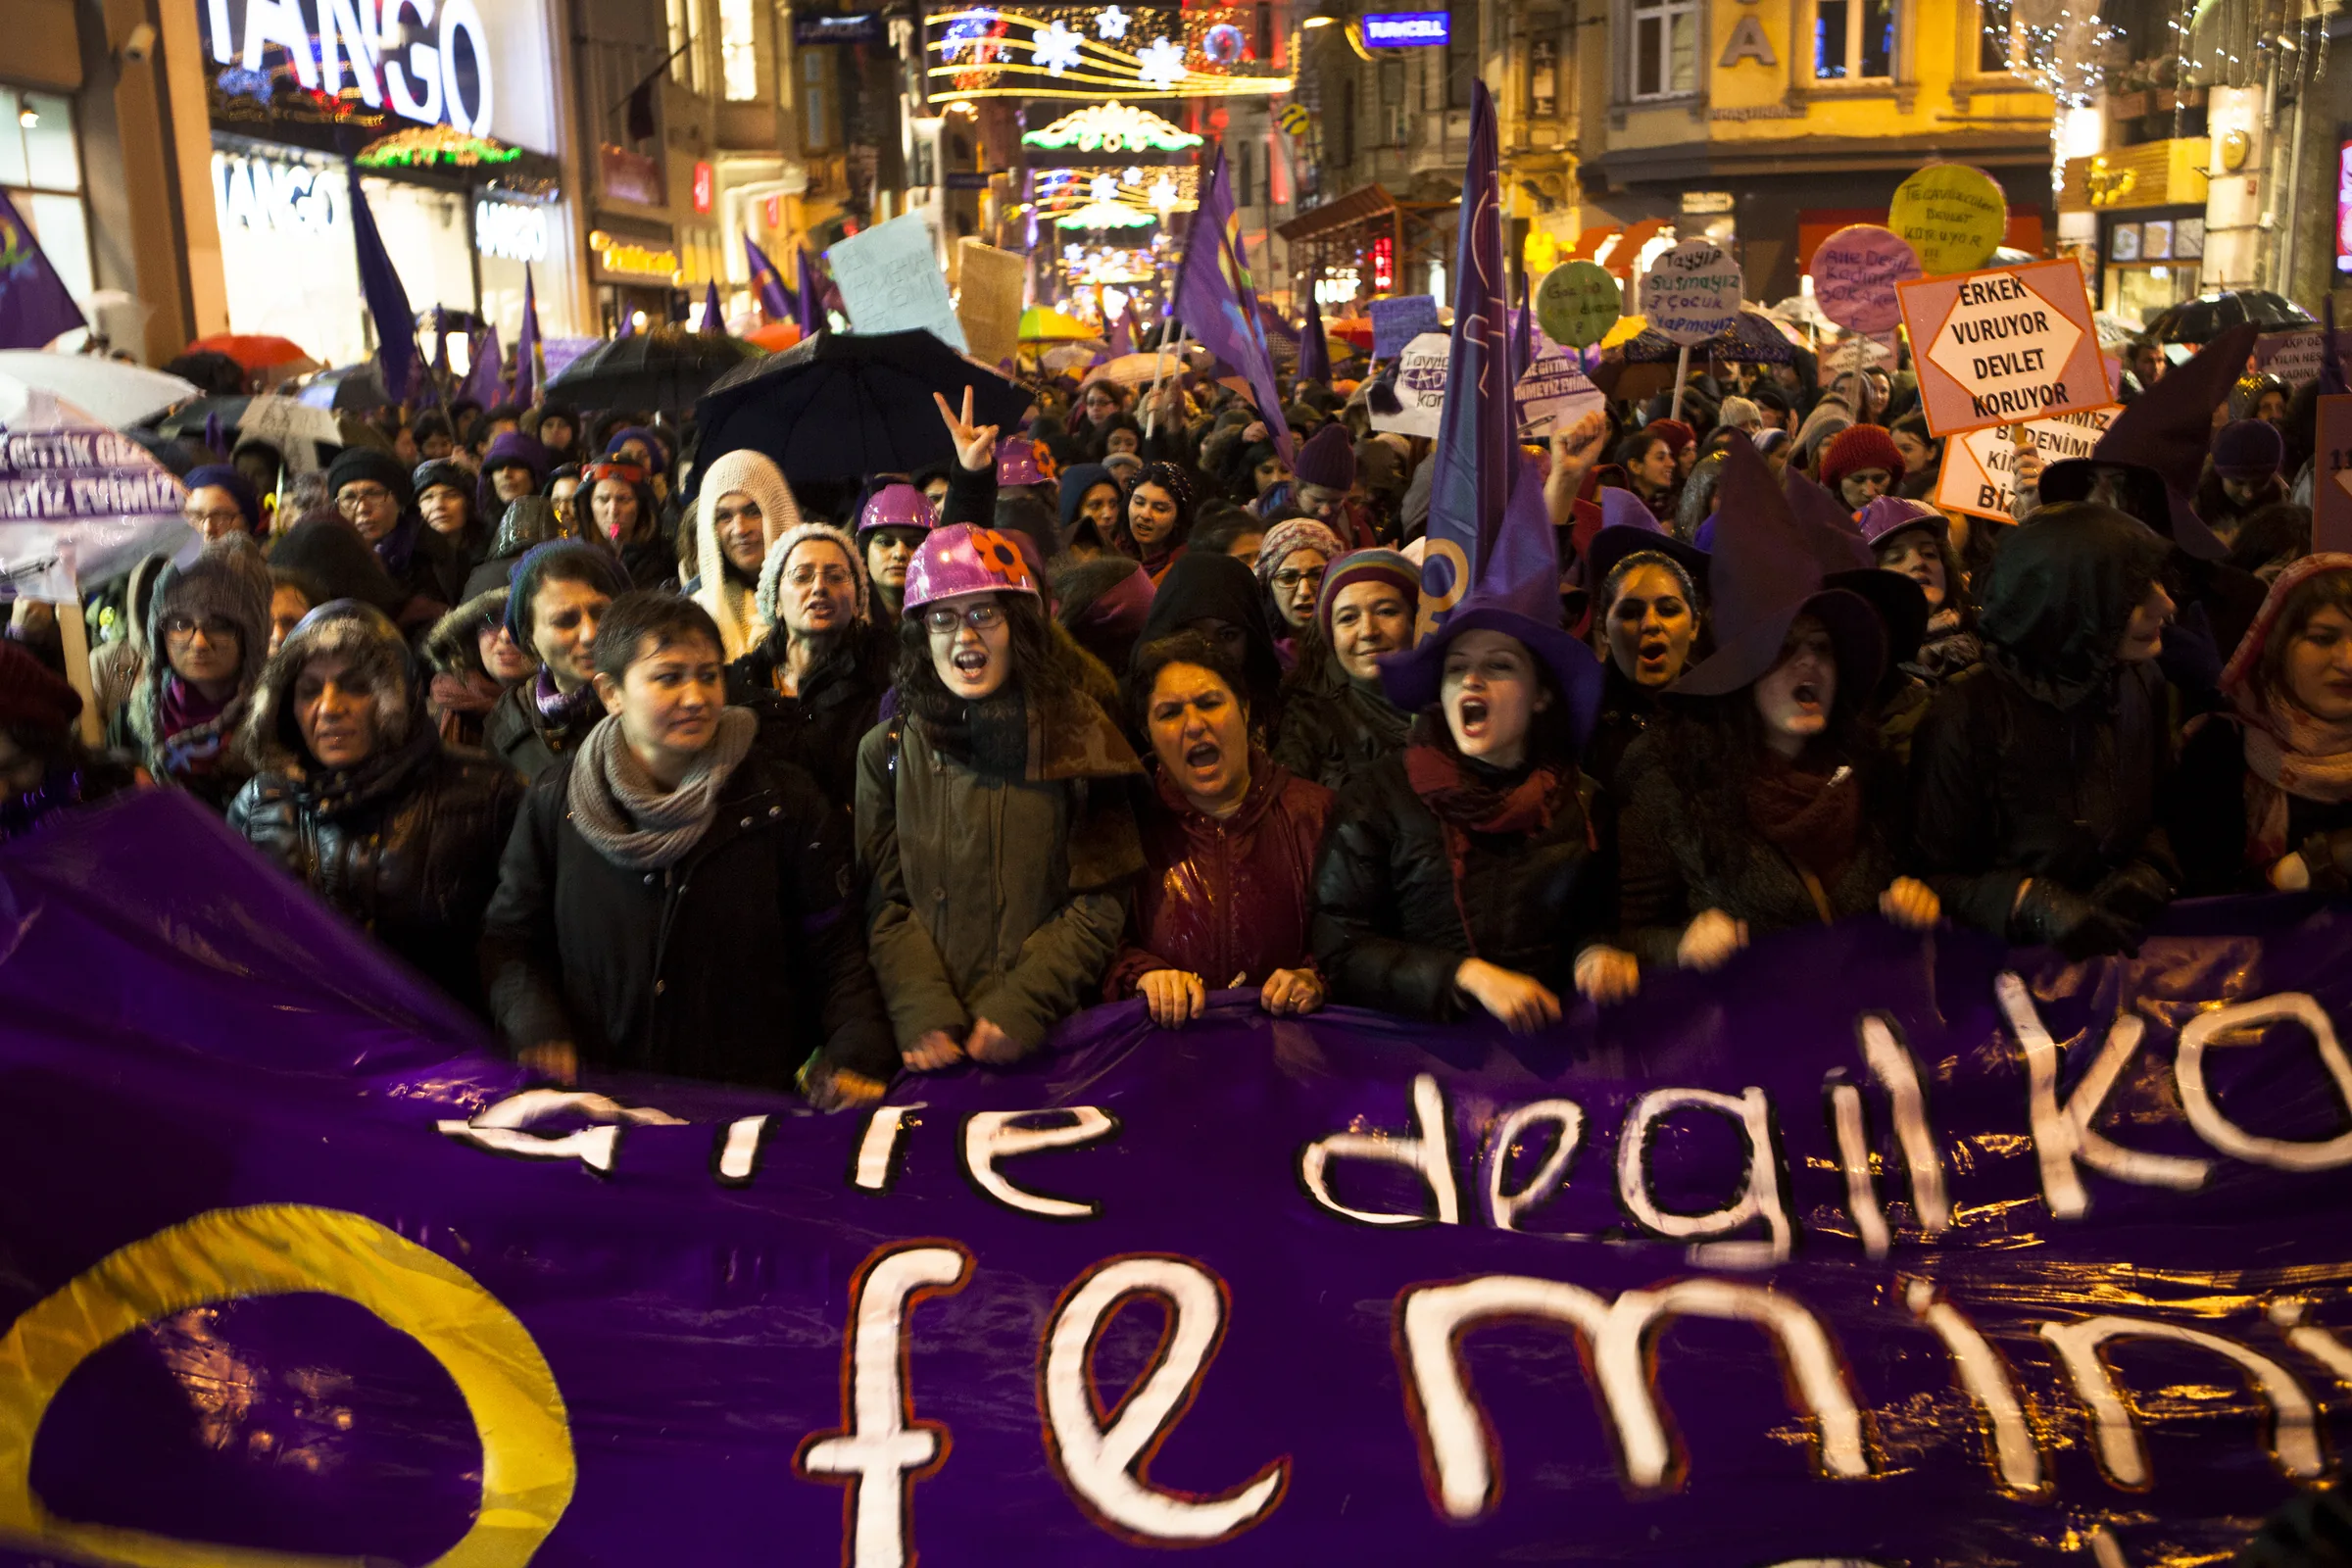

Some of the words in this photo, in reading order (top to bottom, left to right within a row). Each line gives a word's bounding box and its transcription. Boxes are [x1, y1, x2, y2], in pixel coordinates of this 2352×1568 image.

[1958, 276, 2028, 307] ERKEK
[1951, 310, 2049, 345] VURUYOR
[2281, 335, 2324, 349] AKP'DE
[1973, 348, 2045, 380] DEVLET
[1972, 381, 2070, 417] KORUYOR
[1995, 424, 2097, 460] BDENİMİ
